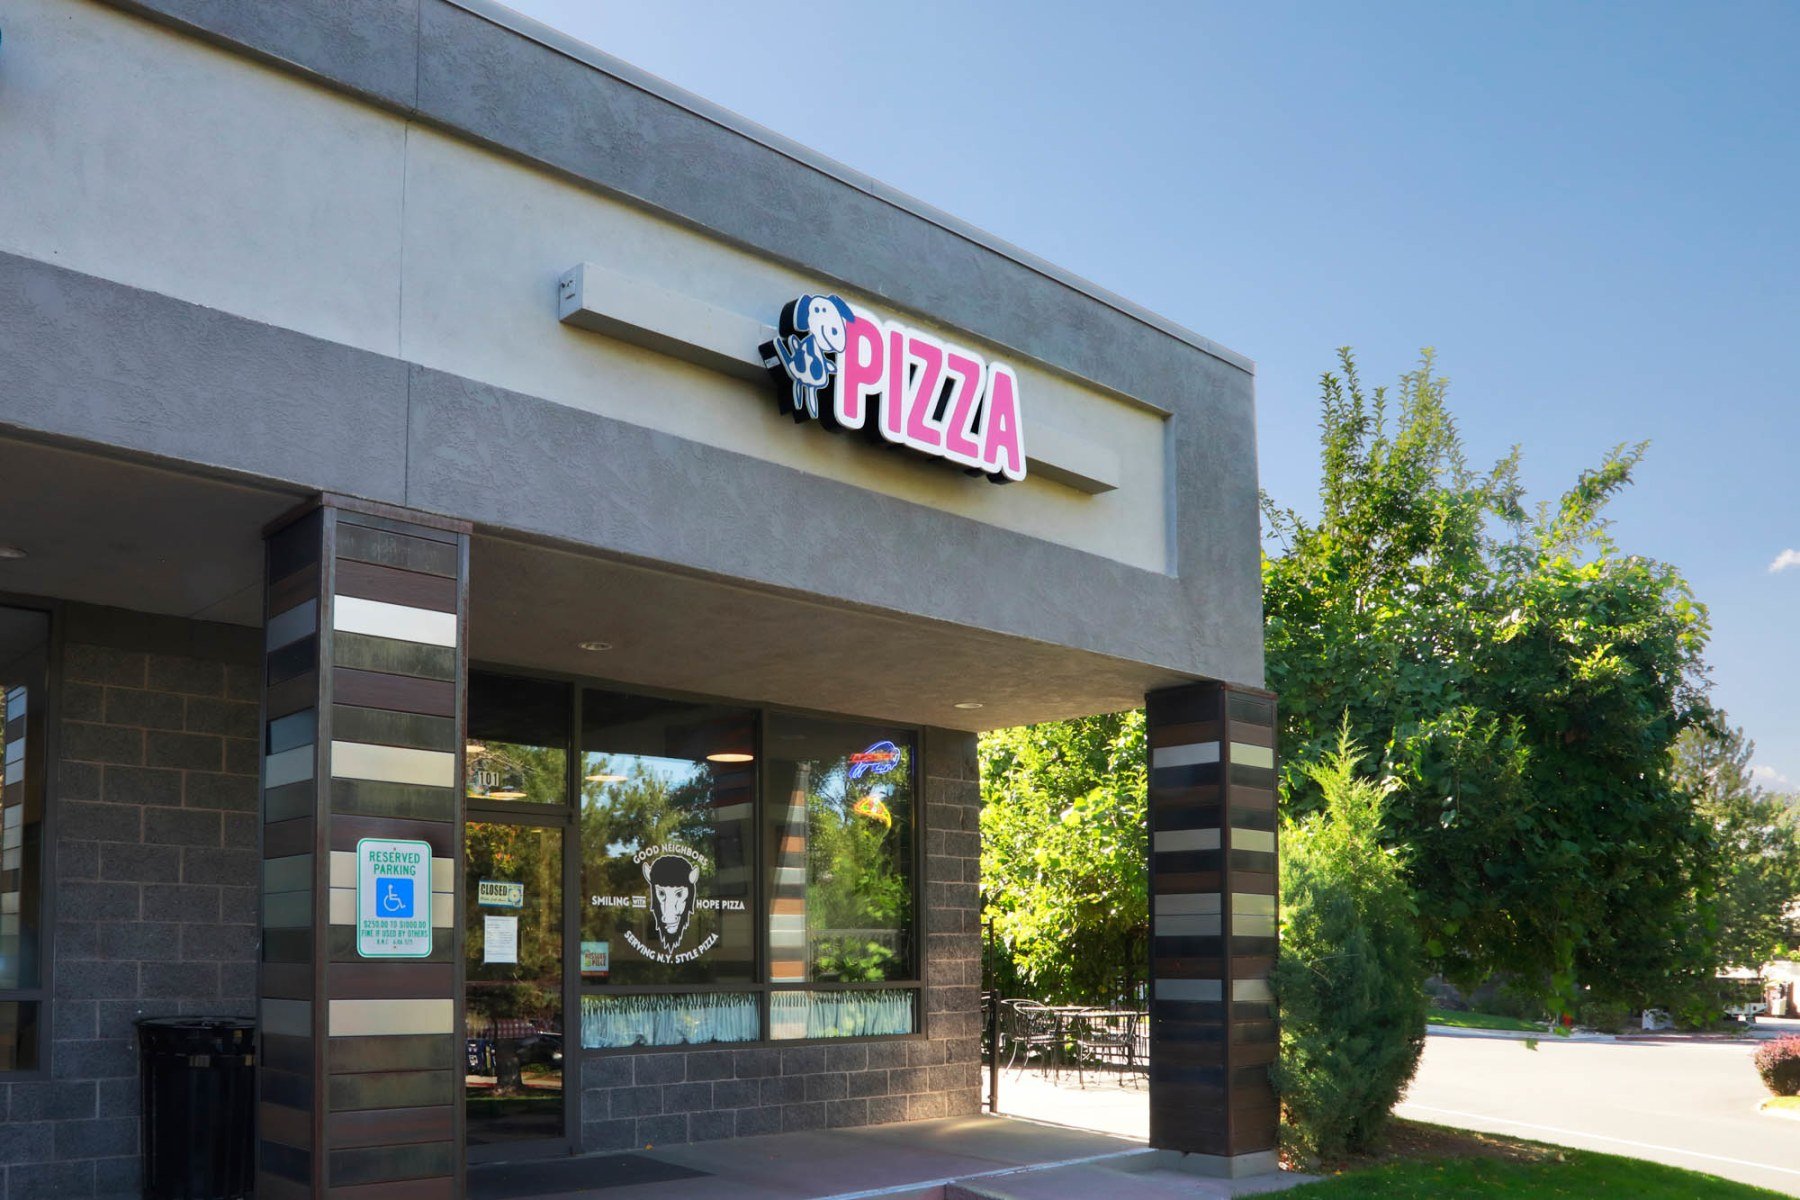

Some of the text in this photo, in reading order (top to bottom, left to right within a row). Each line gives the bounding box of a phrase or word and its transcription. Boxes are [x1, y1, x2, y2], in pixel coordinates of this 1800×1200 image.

[842, 312, 1021, 473] PIZZA
[479, 772, 498, 786] 101
[369, 851, 420, 864] RESERVED
[633, 843, 708, 866] GOOD NEIGHBORS
[373, 864, 416, 876] PARKING
[480, 883, 508, 897] CLOSED
[592, 896, 745, 910] SMILING WITH HOPE PIZZA
[390, 920, 399, 928] TO
[407, 930, 428, 938] OTHERS
[624, 930, 656, 960] SERVING
[657, 954, 673, 964] N.Y.
[675, 949, 698, 964] STYLE
[698, 932, 719, 956] PIZZA
